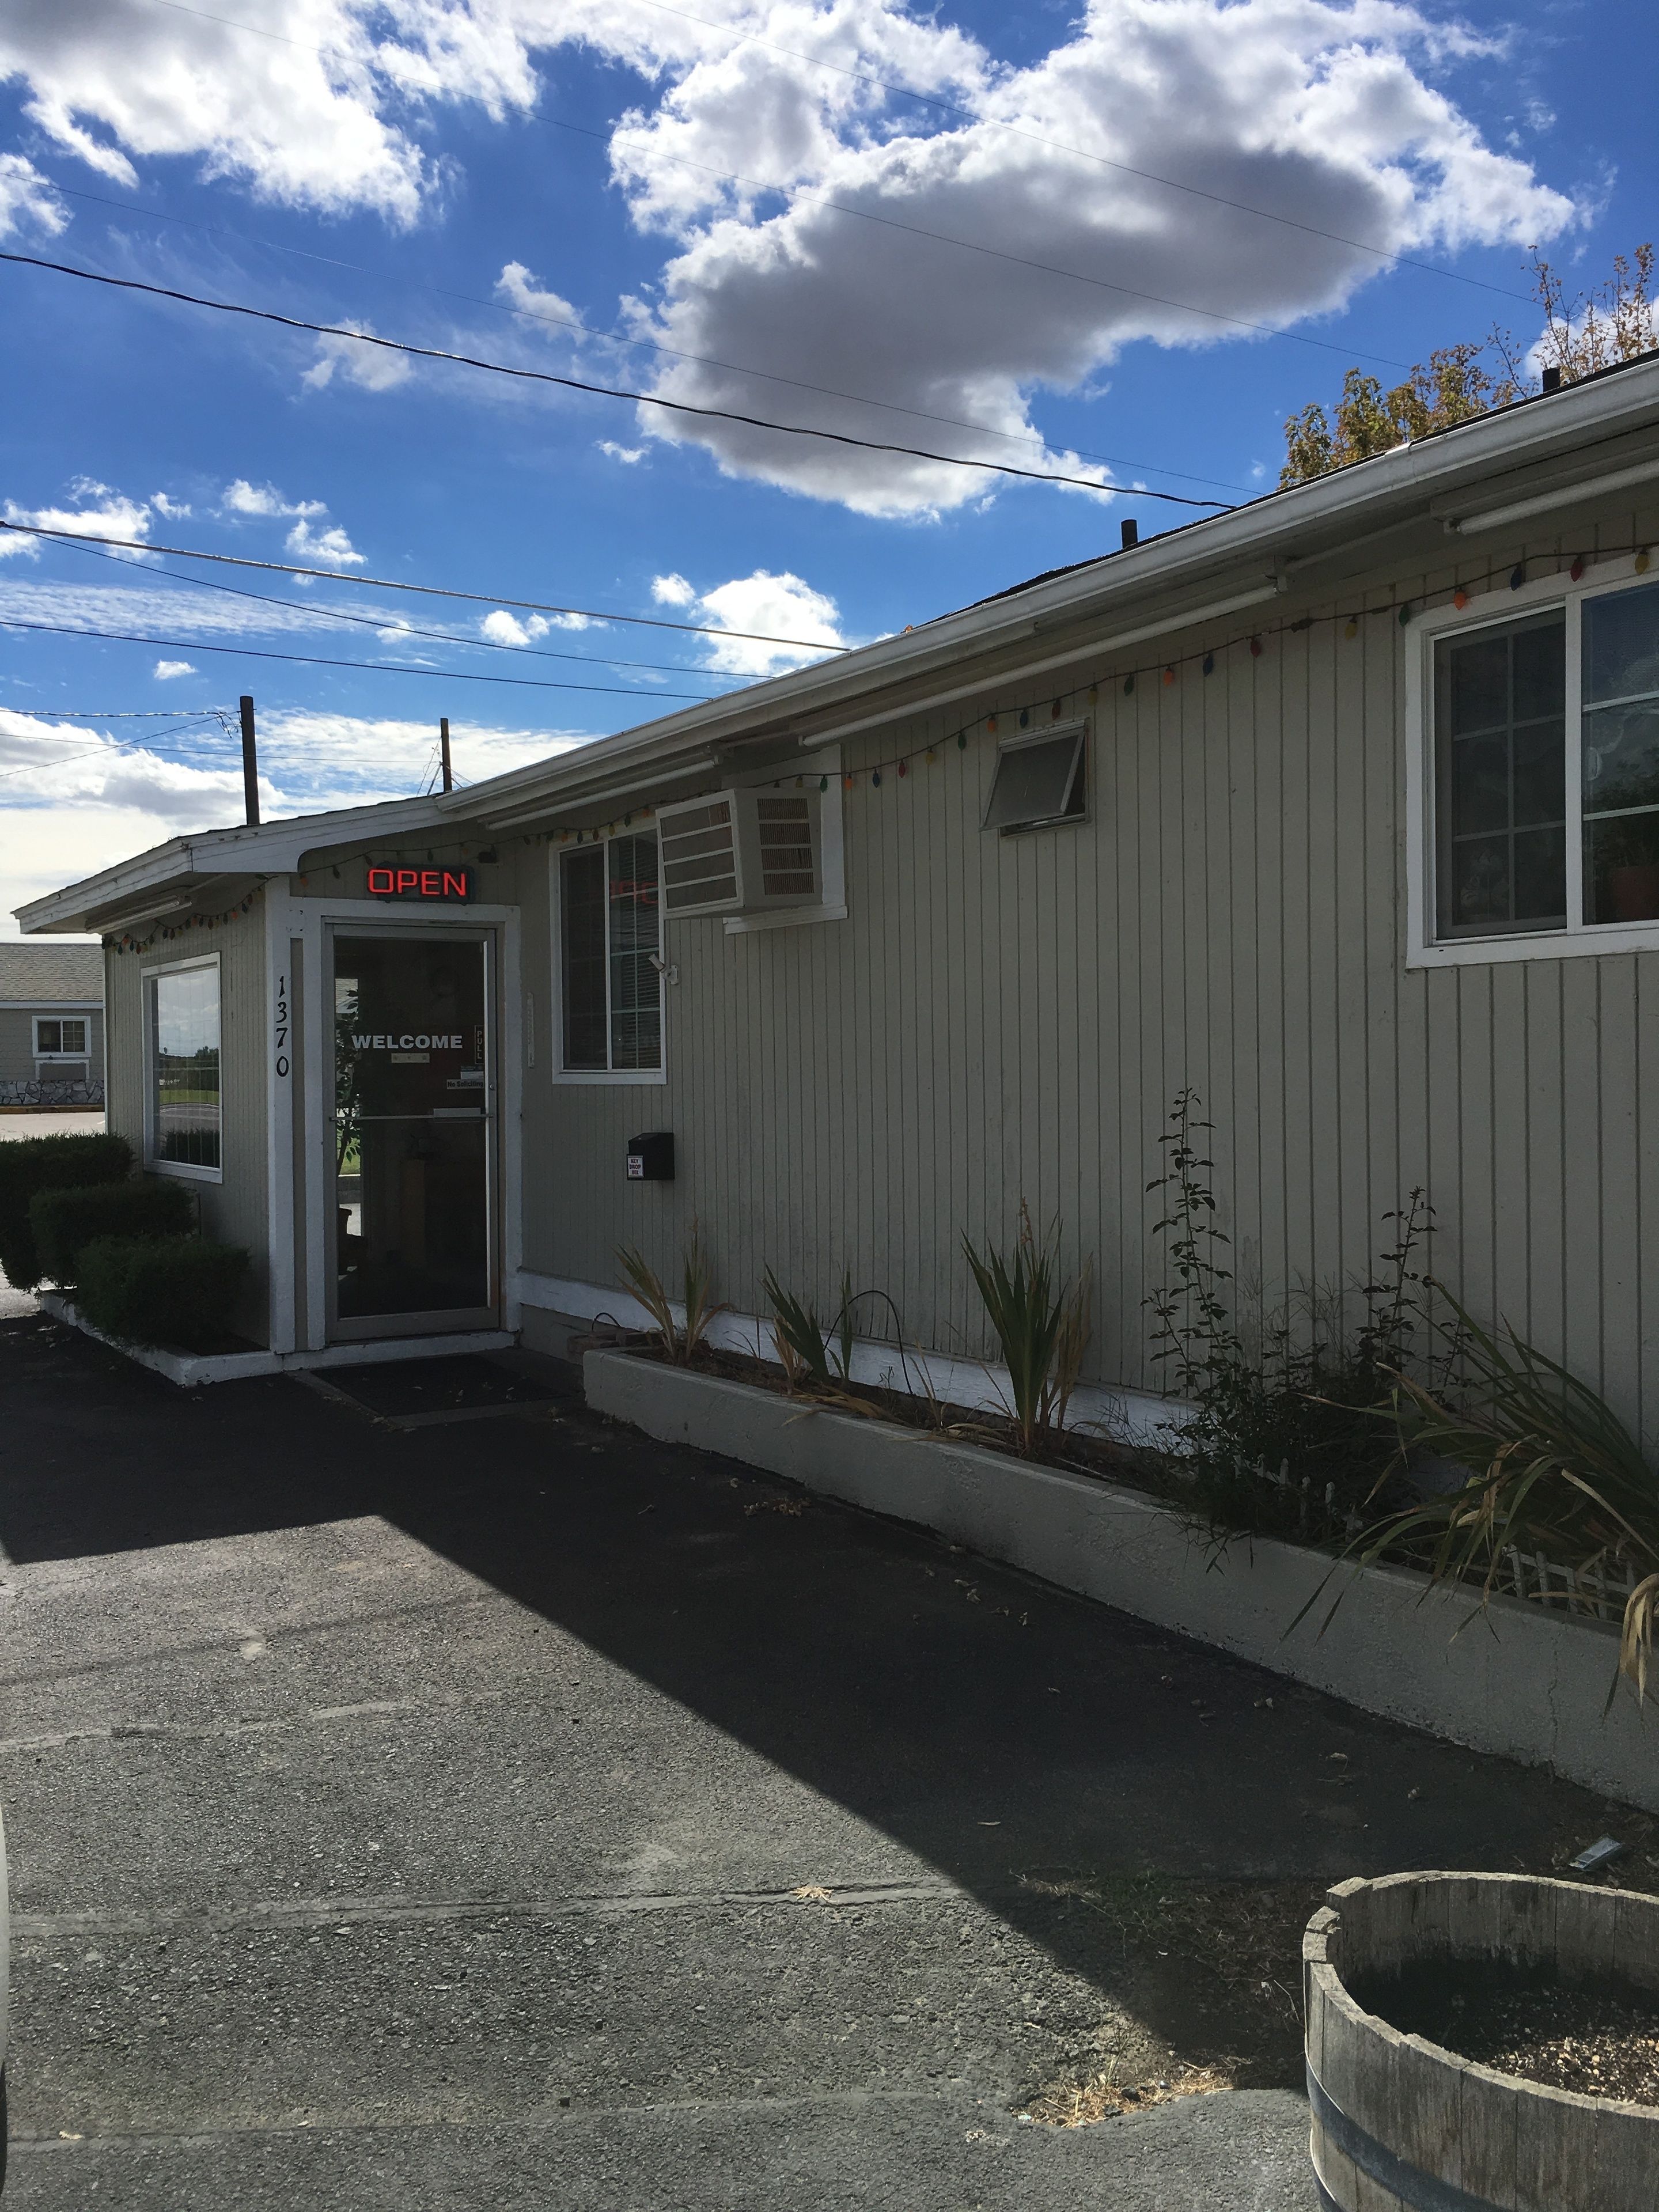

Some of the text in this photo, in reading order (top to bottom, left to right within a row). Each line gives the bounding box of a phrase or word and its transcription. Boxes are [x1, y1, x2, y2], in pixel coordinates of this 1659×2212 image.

[369, 869, 466, 896] OPEN
[276, 976, 289, 1077] 1370
[351, 1035, 463, 1049] WELCOME
